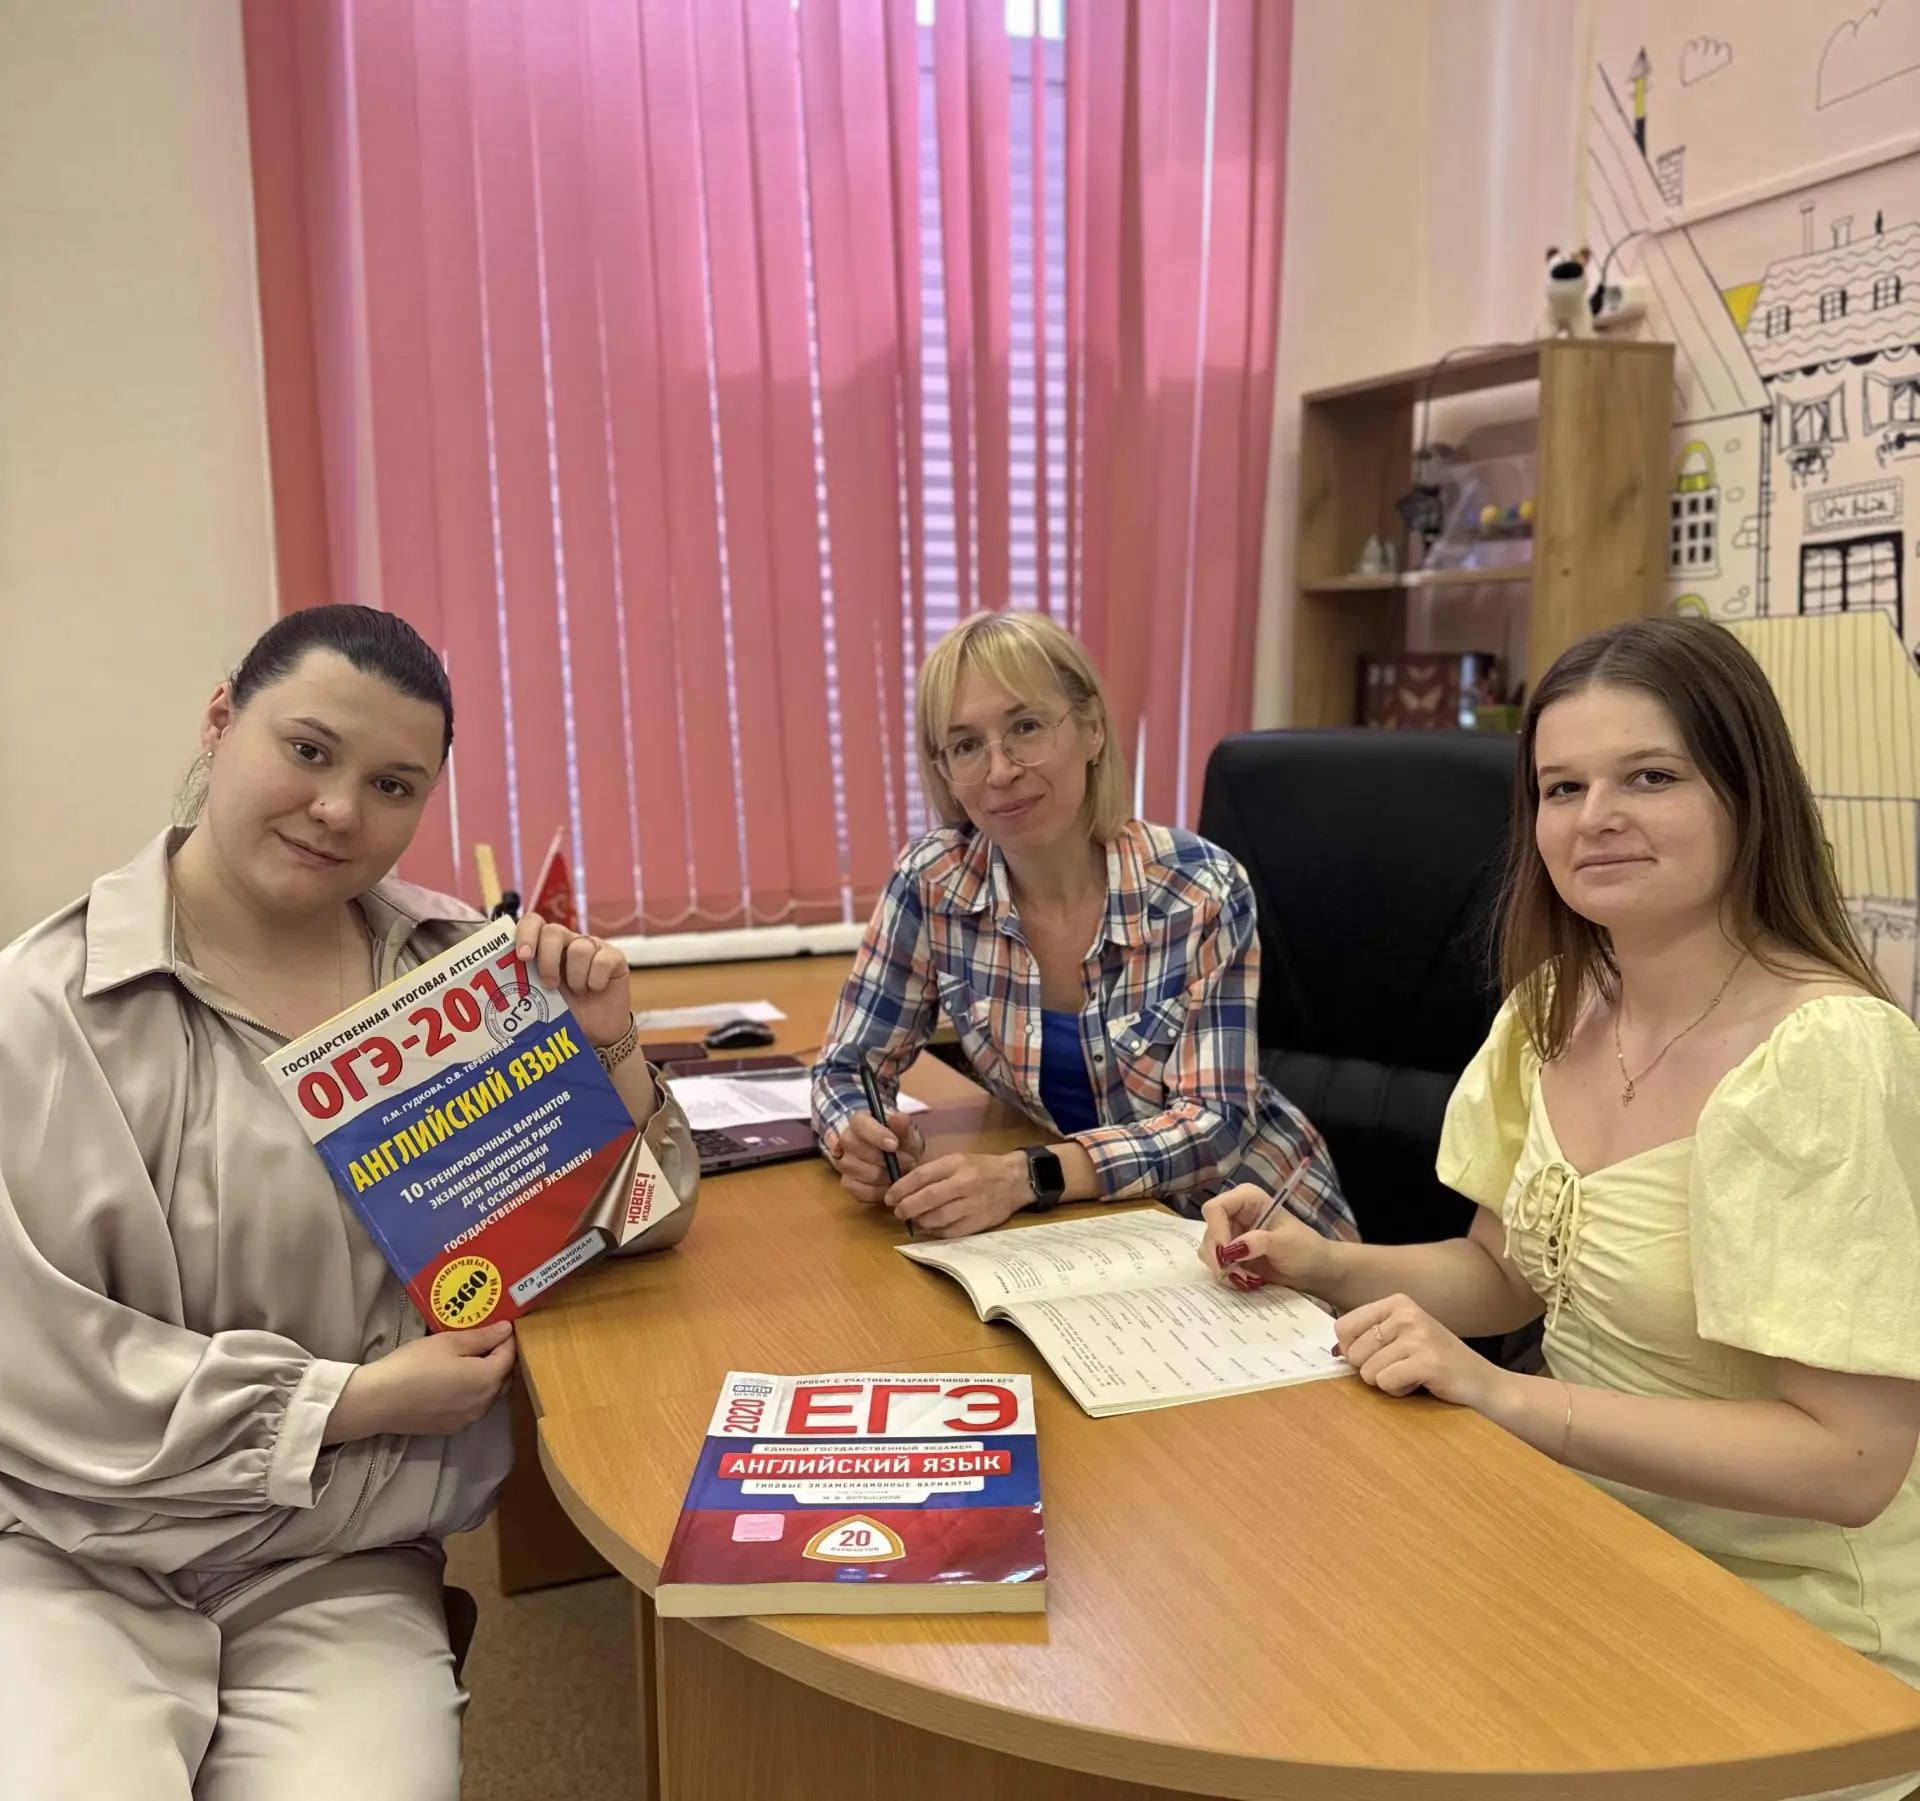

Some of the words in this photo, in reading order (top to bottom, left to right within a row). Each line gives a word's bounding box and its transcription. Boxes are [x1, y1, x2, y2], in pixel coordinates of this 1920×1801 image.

[281, 1008, 390, 1077] ГОСУДАРСТВЕННАЯ
[391, 972, 448, 1012] ИТОГОВАЯ
[449, 932, 510, 977] АТТЕСТАЦИЯ
[503, 998, 532, 1032] ОГЭ
[297, 949, 531, 1119] ОГЭ-2017
[381, 1109, 403, 1125] Л.М.
[402, 1083, 446, 1112] ГУДКОВА,
[445, 1071, 464, 1085] О.В.
[463, 1038, 515, 1073] ТЕРЕНТЬЕВА
[348, 1067, 514, 1193] АНГЛИЙСКИЙ
[508, 1027, 580, 1092] ЯЗЫК
[400, 1182, 425, 1204] 10
[424, 1128, 515, 1190] ТРЕНИРОВОЧНЫХ
[513, 1091, 571, 1133] ВАРИАНТОВ
[429, 1136, 532, 1209] ЭКЗАМЕНАЦИОННЫХ
[531, 1115, 564, 1142] РАБОТ
[444, 1180, 544, 1254] ГОСУДАРСТВЕННОМУ
[543, 1147, 593, 1187] ЭКЗАМЕНУ
[461, 1188, 484, 1208] ДЛЯ
[484, 1143, 550, 1191] ПОДГОТОВКИ
[477, 1203, 489, 1214] К
[488, 1161, 547, 1207] ОСНОВНОМУ
[627, 1173, 656, 1224] НОВОЕ!
[642, 1184, 655, 1221] ИЗДАНИЕ
[433, 1258, 490, 1322] ТРЕНИРОВОЧНЫХ
[517, 1277, 534, 1292] ОГЭ
[540, 1237, 594, 1277] ШКОЛЬНИКАМ
[536, 1281, 543, 1289] И
[543, 1254, 583, 1283] УЧИТЕЛЯМ
[444, 1270, 488, 1317] 360
[735, 1385, 771, 1394] ФИПИ
[785, 1384, 1019, 1435] ЕГЭ
[723, 1398, 766, 1434] 2020
[729, 1455, 910, 1474] АНГЛИЙСКИЙ
[922, 1455, 1001, 1473] ЯЗЫК
[923, 1443, 973, 1451] ЭКЗАМЕН
[917, 1480, 972, 1488] ВАРИАНТЫ
[839, 1530, 871, 1546] 20
